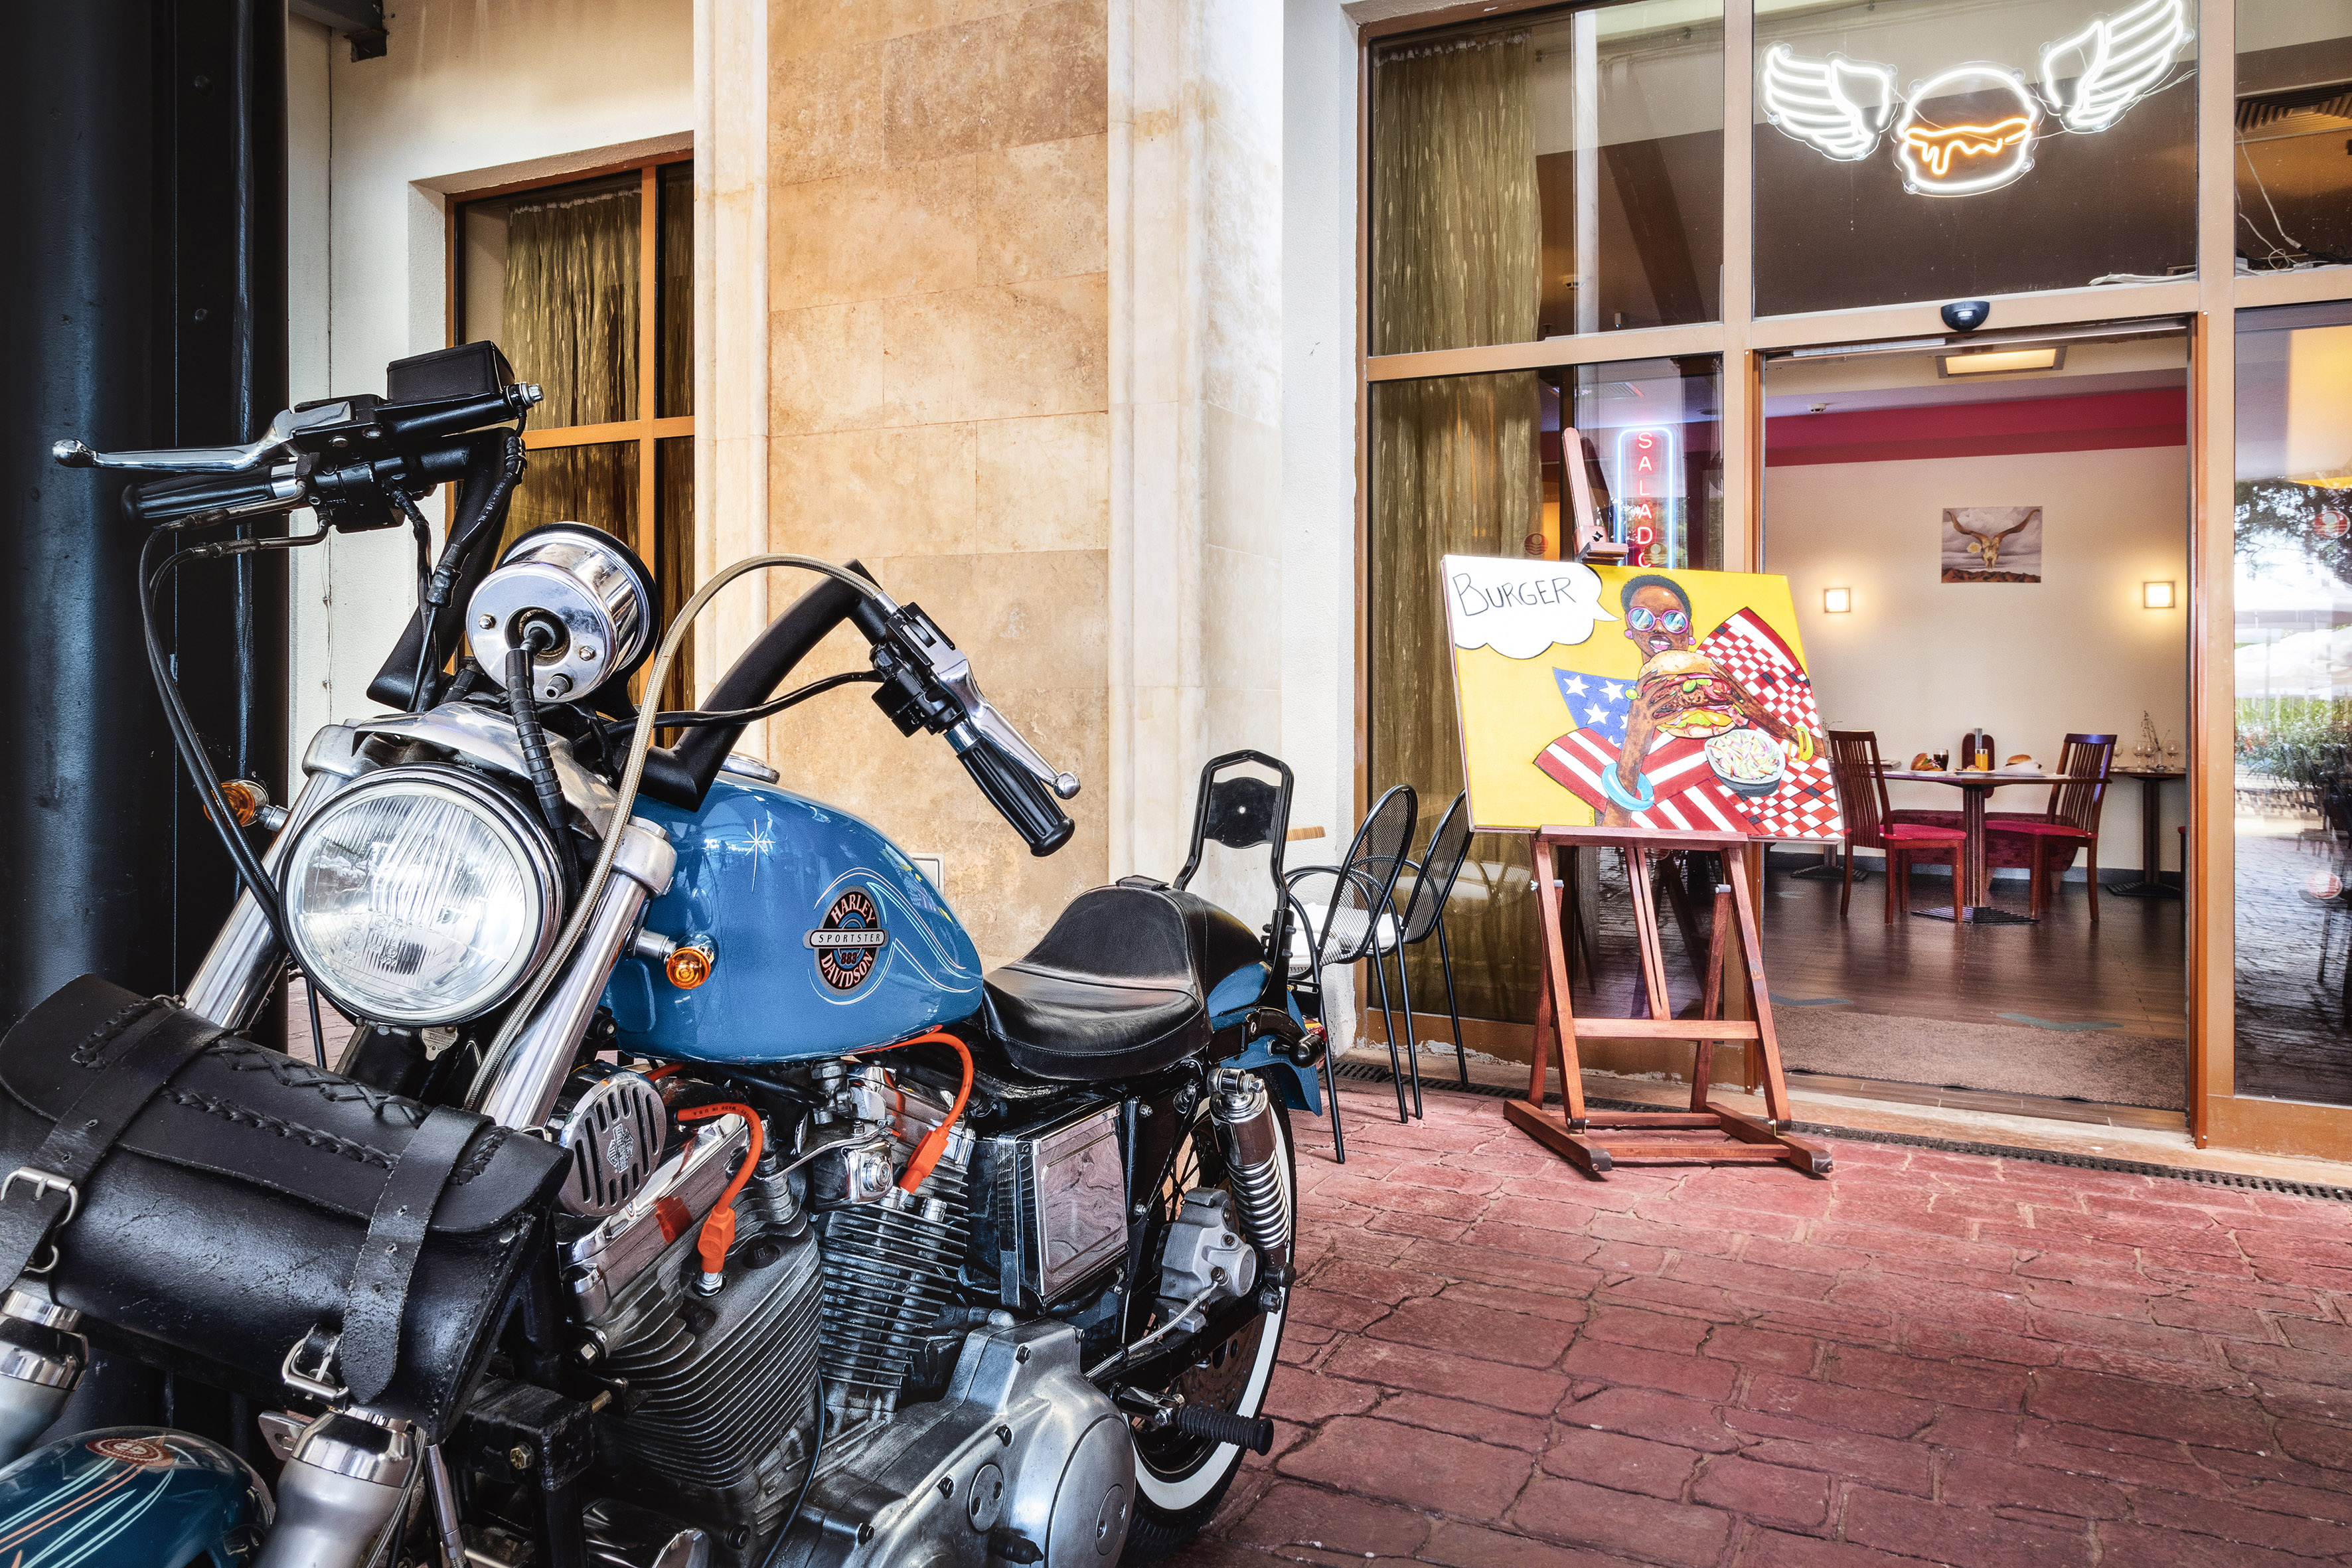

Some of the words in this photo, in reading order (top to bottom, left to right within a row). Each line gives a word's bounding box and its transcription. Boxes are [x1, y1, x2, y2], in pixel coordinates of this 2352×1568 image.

[1452, 573, 1577, 617] BURGER
[830, 894, 876, 925] HARLEY
[819, 933, 881, 943] SPORTSTER
[821, 951, 874, 988] DAVIDSON
[840, 952, 858, 965] 883
